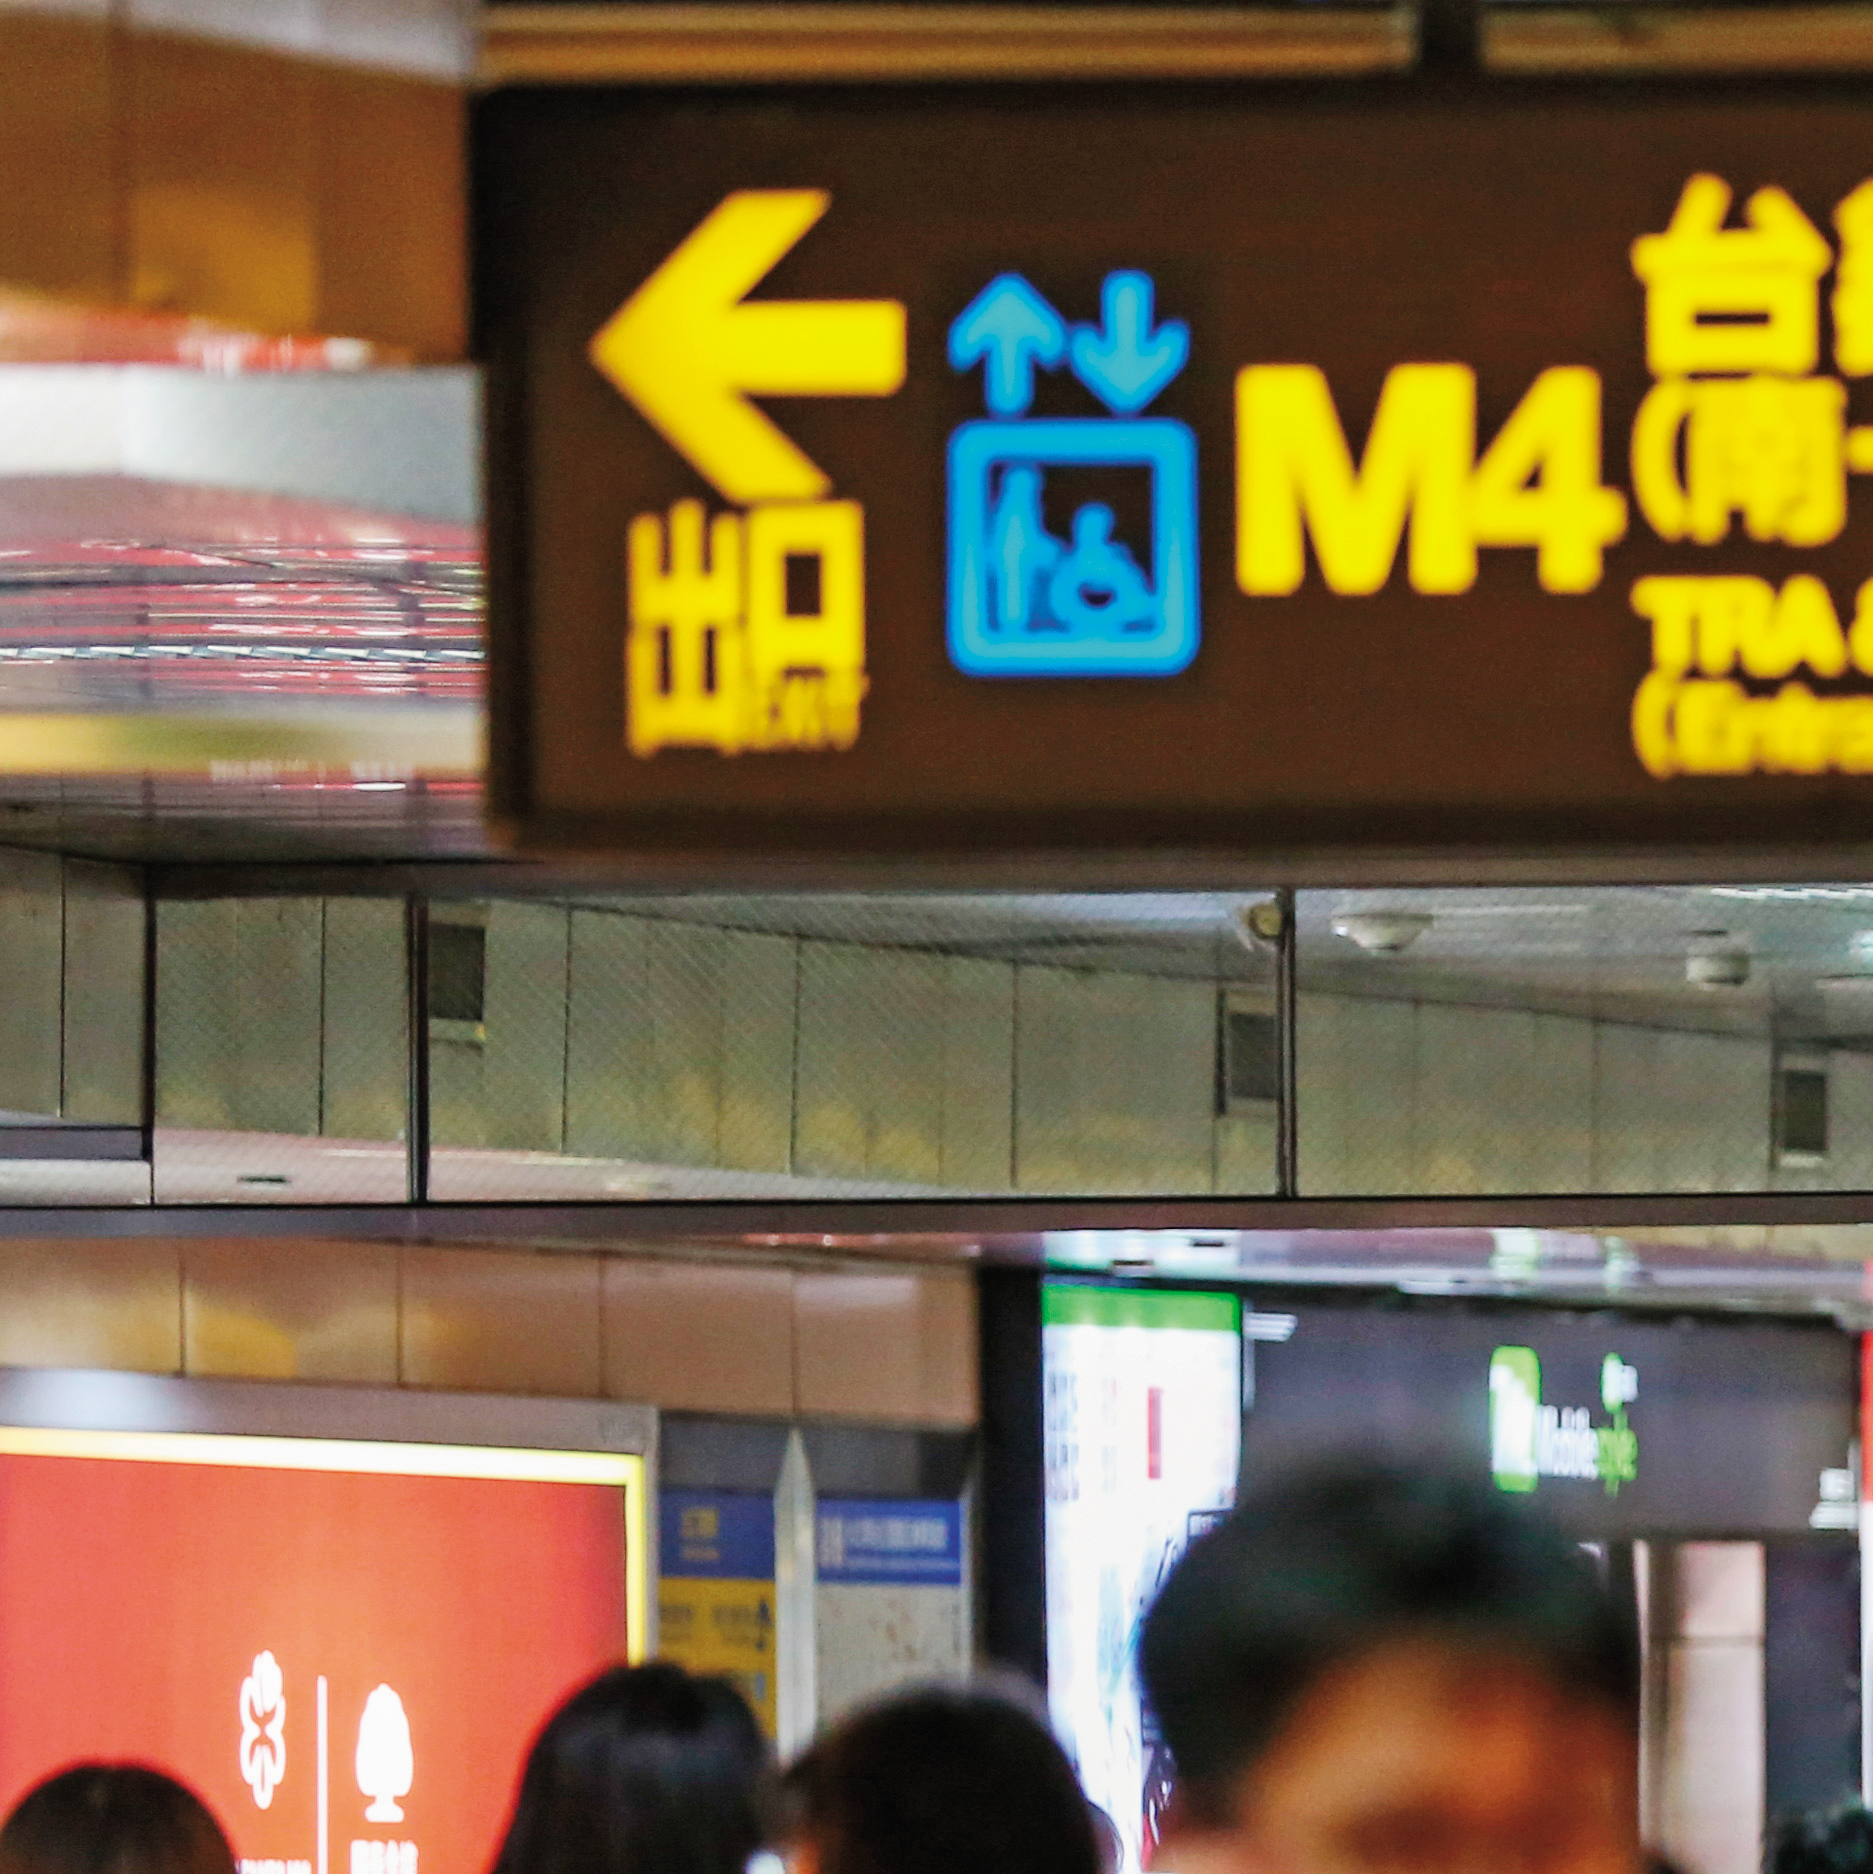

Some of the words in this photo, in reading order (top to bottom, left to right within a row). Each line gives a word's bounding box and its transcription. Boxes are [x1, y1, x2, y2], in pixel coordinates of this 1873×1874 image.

[1234, 362, 1629, 597] M4
[625, 499, 869, 757] 出口
[1630, 572, 1849, 679] TRA
